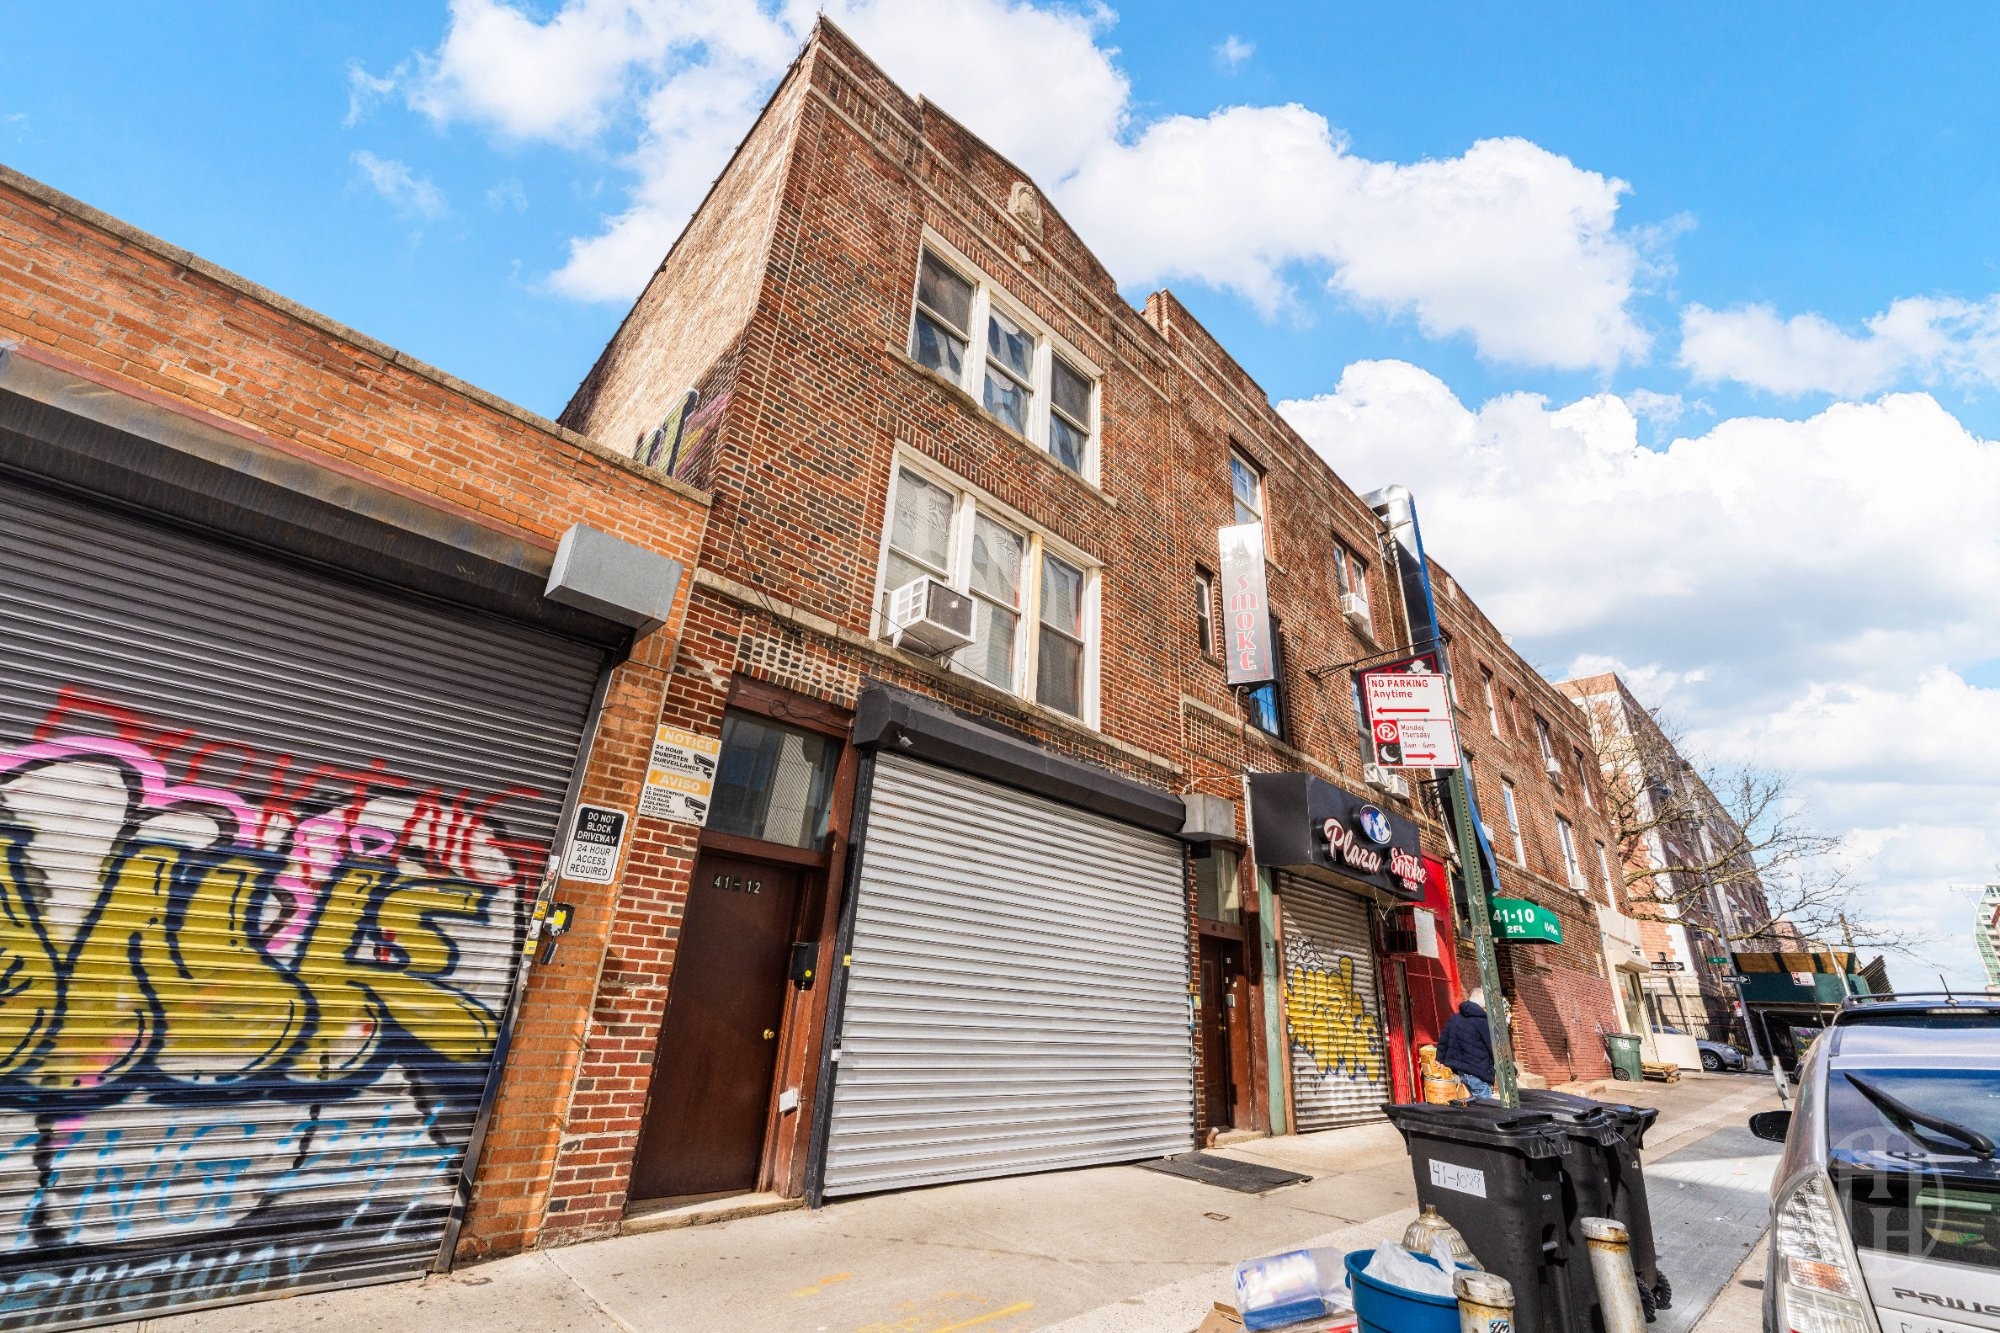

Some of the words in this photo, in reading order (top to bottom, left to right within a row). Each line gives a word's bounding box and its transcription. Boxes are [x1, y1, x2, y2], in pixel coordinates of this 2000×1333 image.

[1230, 574, 1258, 671] SMOKE
[1371, 679, 1384, 688] NO
[1387, 679, 1429, 688] PARKING
[1373, 690, 1413, 700] Anytime
[1401, 724, 1424, 732] Monday
[665, 729, 713, 752] NOTICE
[1403, 731, 1430, 739] Thursday
[654, 750, 689, 763] DUMPSTER
[665, 746, 684, 755] HOUR
[653, 756, 701, 772] SURVEILLANCE
[659, 774, 701, 792] AVISO
[588, 812, 599, 822] DO
[600, 814, 616, 824] NOT
[587, 822, 613, 834] BLOCK
[577, 831, 617, 844] DRIVEWAY
[576, 844, 588, 852] 24
[590, 846, 611, 856] HOUR
[1324, 818, 1381, 873] Plaza
[576, 855, 607, 866] ACCESS
[1390, 847, 1427, 884] Smoke
[569, 864, 608, 876] REQUIRED
[1403, 879, 1418, 892] SHOP
[1493, 908, 1535, 923] 41-10
[1506, 925, 1526, 933] 2FL
